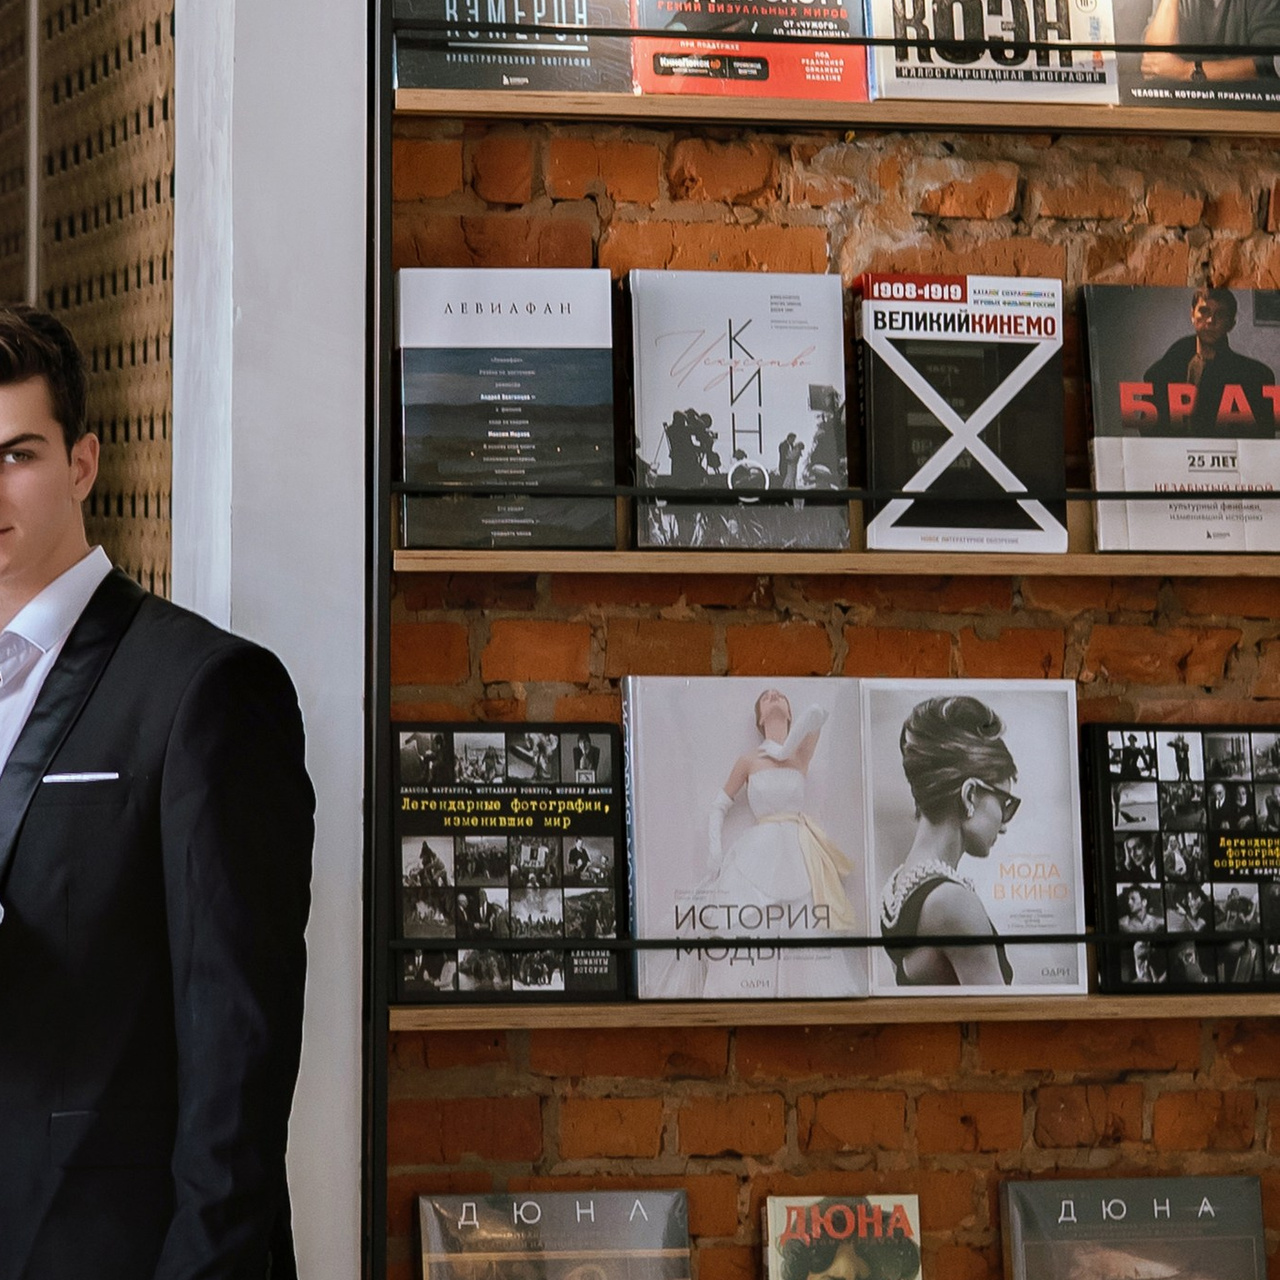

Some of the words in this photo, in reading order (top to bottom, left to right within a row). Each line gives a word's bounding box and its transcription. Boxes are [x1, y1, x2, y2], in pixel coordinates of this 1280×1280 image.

[657, 0, 701, 12] ГЕНИЙ
[707, 2, 797, 17] ВИЗУАЛЬНЫХ
[802, 5, 848, 19] МИРОВ
[873, 282, 963, 300] 1908-1919
[1187, 455, 1206, 467] 25
[1210, 455, 1238, 469] ЛЕТ
[401, 797, 502, 813] Легендарные
[510, 797, 610, 814] фотографии,
[443, 815, 534, 827] изменившие
[544, 815, 571, 829] мир
[999, 863, 1061, 881] МОДА
[993, 884, 1006, 900] В
[1011, 883, 1070, 900] КИНО
[675, 904, 830, 930] ИСТОРИЯ
[1041, 967, 1070, 977] ОДРИ
[740, 979, 770, 989] ОДРИ
[458, 1198, 649, 1230] ДЮНА
[1058, 1196, 1216, 1223] ДЮНА
[780, 1204, 914, 1247] ДЮНА
